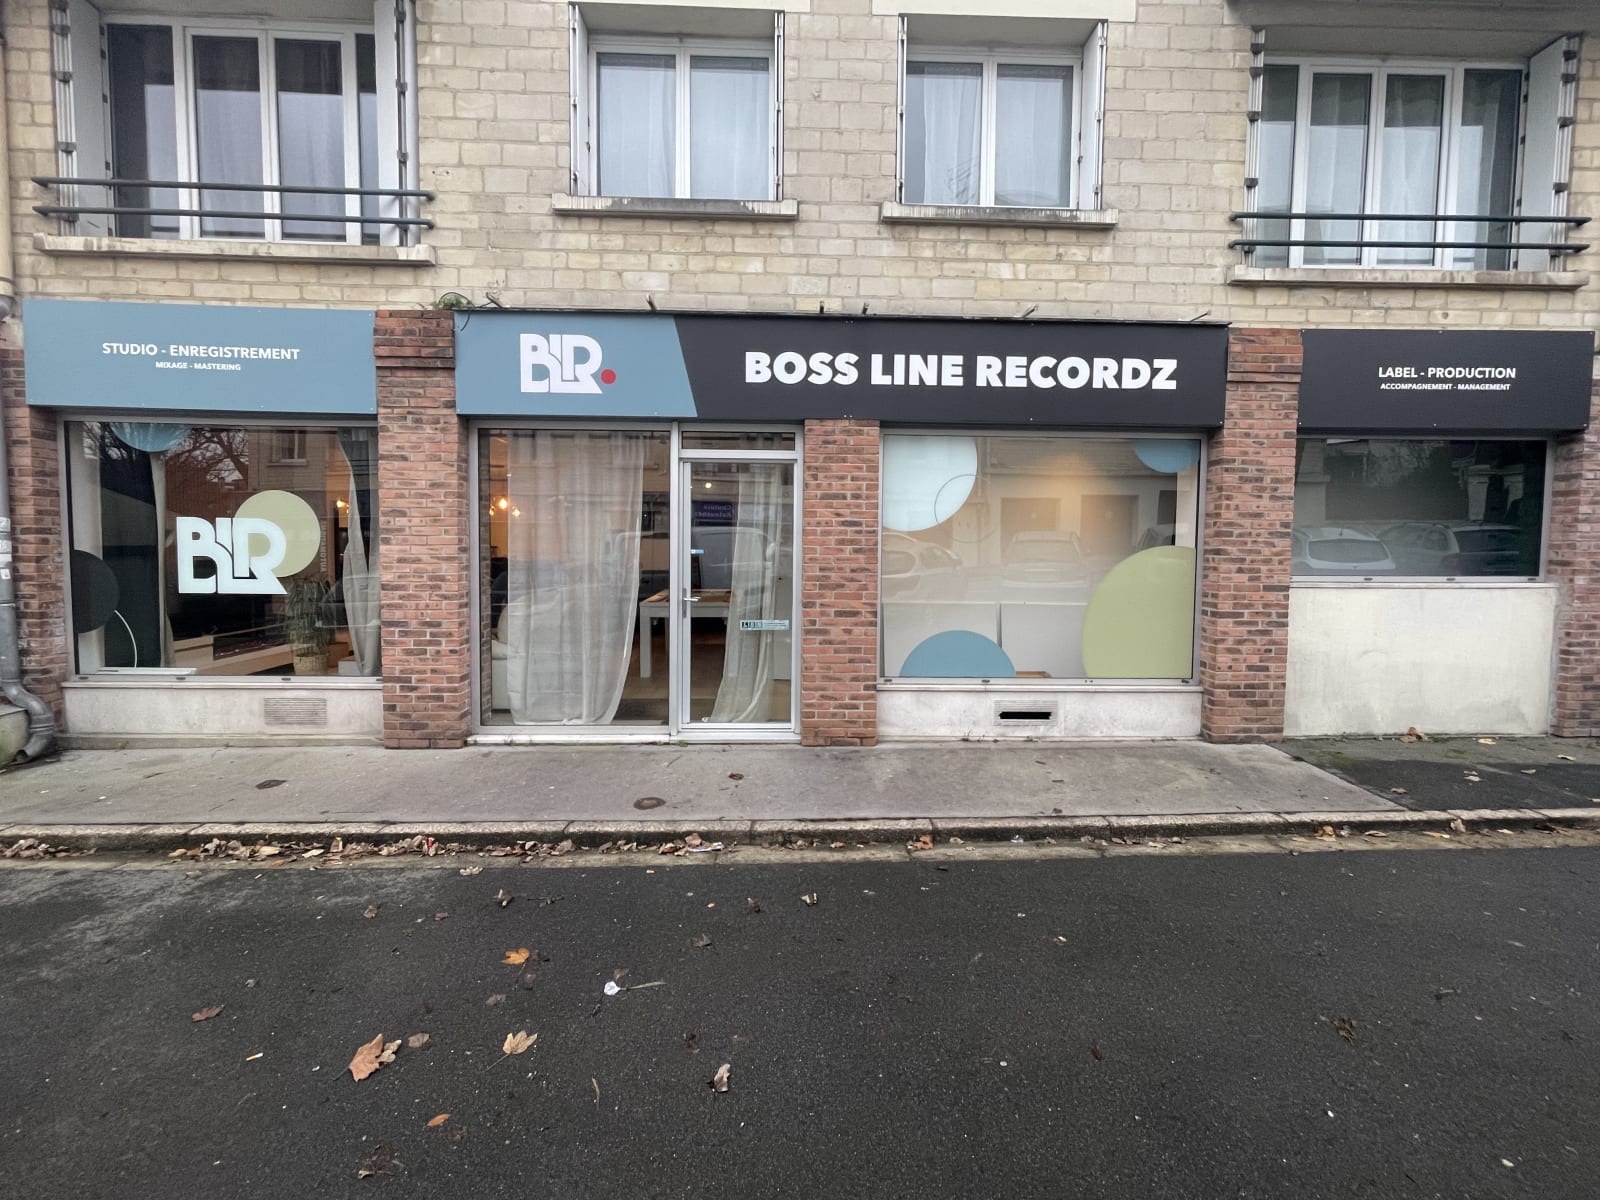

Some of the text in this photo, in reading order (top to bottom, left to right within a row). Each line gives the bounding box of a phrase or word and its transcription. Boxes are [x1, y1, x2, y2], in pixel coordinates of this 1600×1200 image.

[102, 342, 158, 356] STUDIO
[169, 344, 301, 360] ENREGISTREMENT
[155, 361, 188, 369] MIXAGE
[193, 362, 242, 371] MASTERING
[745, 351, 1178, 390] BOSS LINE RECORDZ
[1378, 366, 1418, 378] LABEL
[1427, 367, 1517, 379] PRODUCTION
[1379, 382, 1454, 391] ACCOMPAGNEMENT
[1457, 383, 1512, 391] MANAGEMENT
[176, 516, 288, 595] BLR
